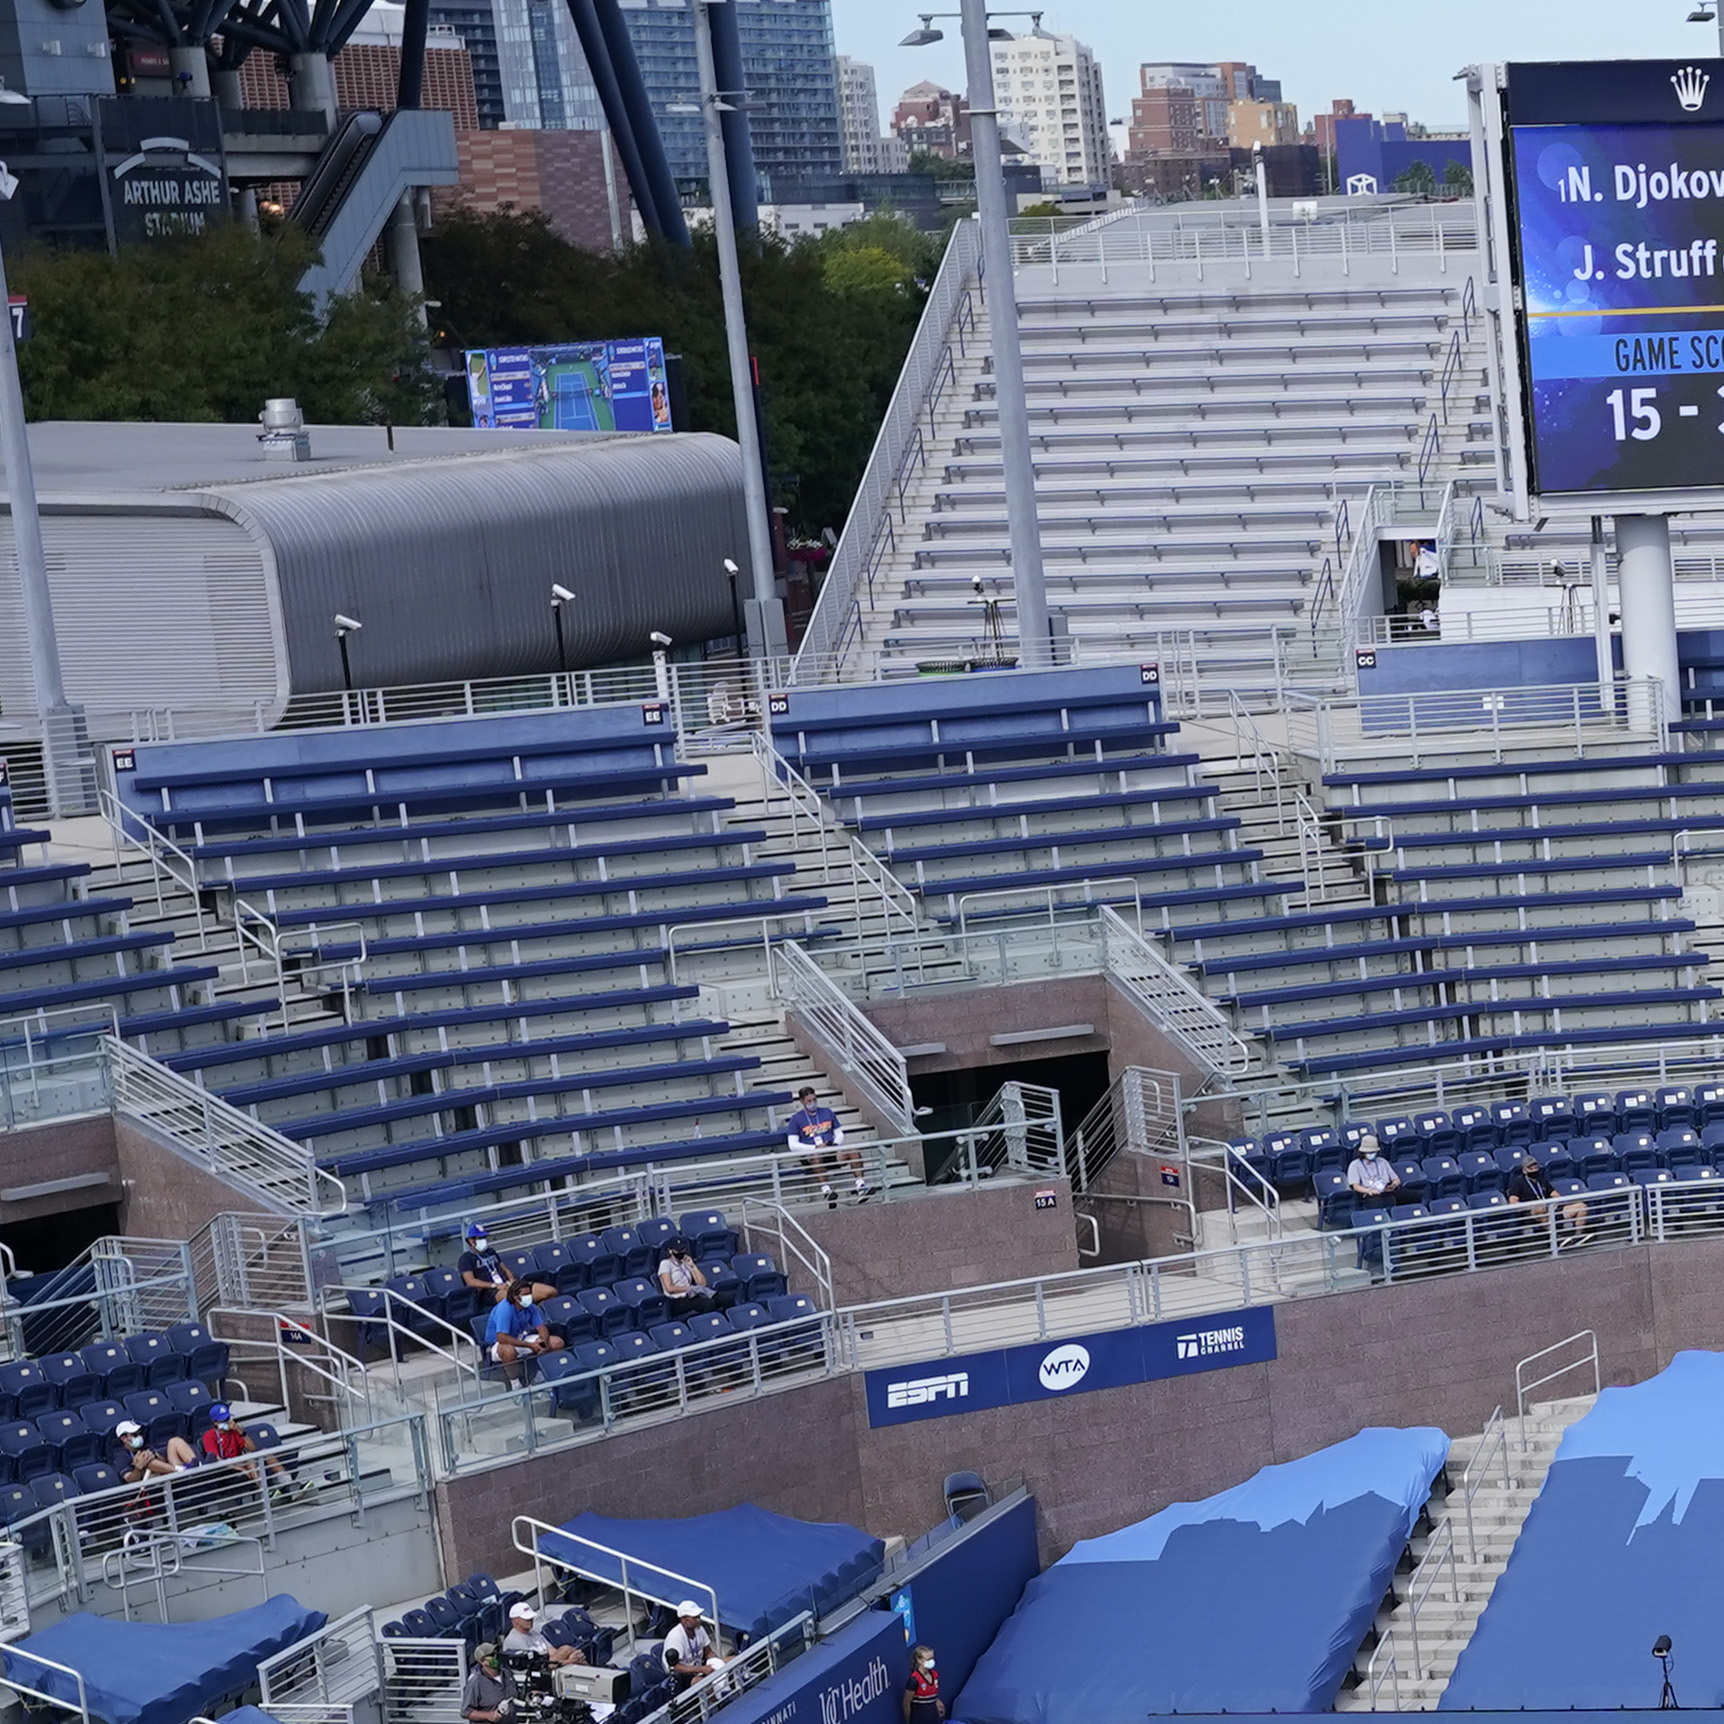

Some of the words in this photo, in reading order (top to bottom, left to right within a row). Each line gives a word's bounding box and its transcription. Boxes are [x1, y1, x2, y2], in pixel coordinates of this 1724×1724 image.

[124, 180, 180, 204] ARTHUR
[184, 180, 221, 204] ASHE
[1569, 166, 1604, 202] N.
[1573, 245, 1605, 281] J.
[1615, 238, 1718, 279] Struff
[12, 307, 24, 338] 7
[1615, 336, 1680, 372] GAME
[1606, 388, 1661, 441] 15
[1358, 656, 1374, 666] CC
[1142, 671, 1158, 681] DD
[771, 700, 788, 711] DD
[645, 711, 661, 722] EE
[116, 757, 133, 769] EE
[1199, 1327, 1244, 1346] TENNIS
[1200, 1342, 1245, 1355] CHANNEL
[1043, 1358, 1085, 1377] WTA
[887, 1372, 969, 1408] ESPN
[841, 1656, 888, 1720] Health
